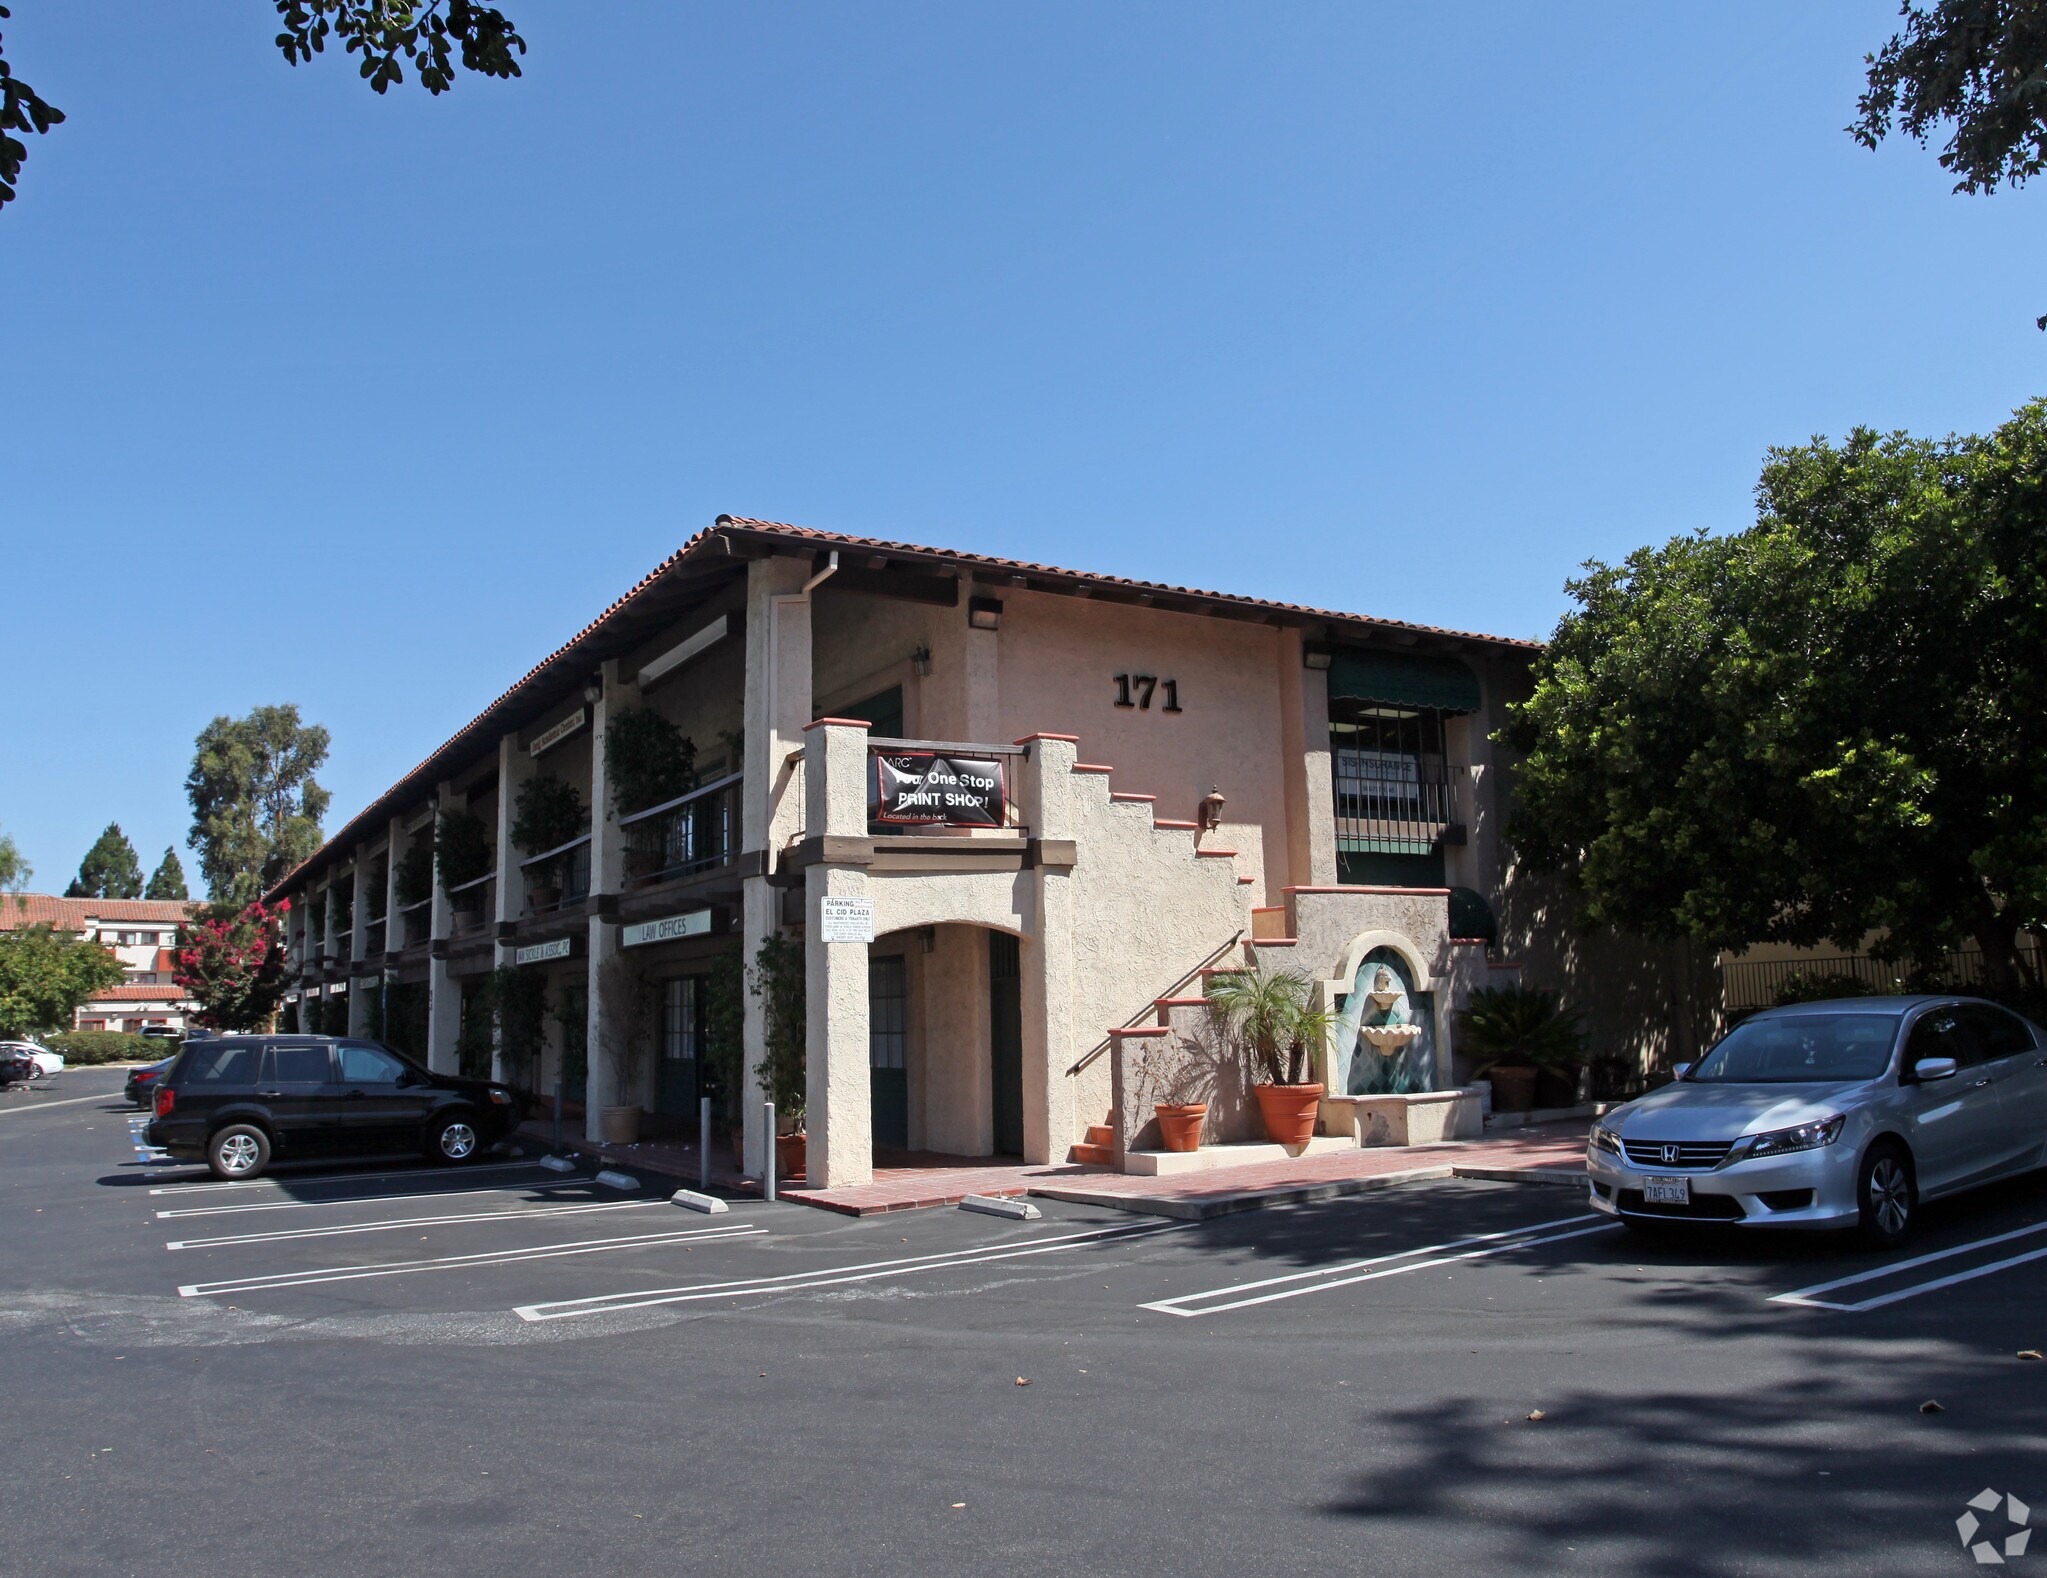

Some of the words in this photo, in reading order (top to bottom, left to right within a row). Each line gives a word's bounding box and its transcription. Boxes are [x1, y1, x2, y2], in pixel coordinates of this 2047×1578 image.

[1113, 673, 1183, 712] 171
[927, 771, 957, 785] One
[959, 774, 994, 791] Stop
[898, 792, 941, 806] PRINT
[945, 793, 989, 809] SHOP!
[883, 811, 912, 820] Located
[932, 813, 947, 821] back
[641, 923, 657, 941] LAW
[658, 918, 687, 938] OFFICES
[1647, 1186, 1686, 1200] 7AFL349
